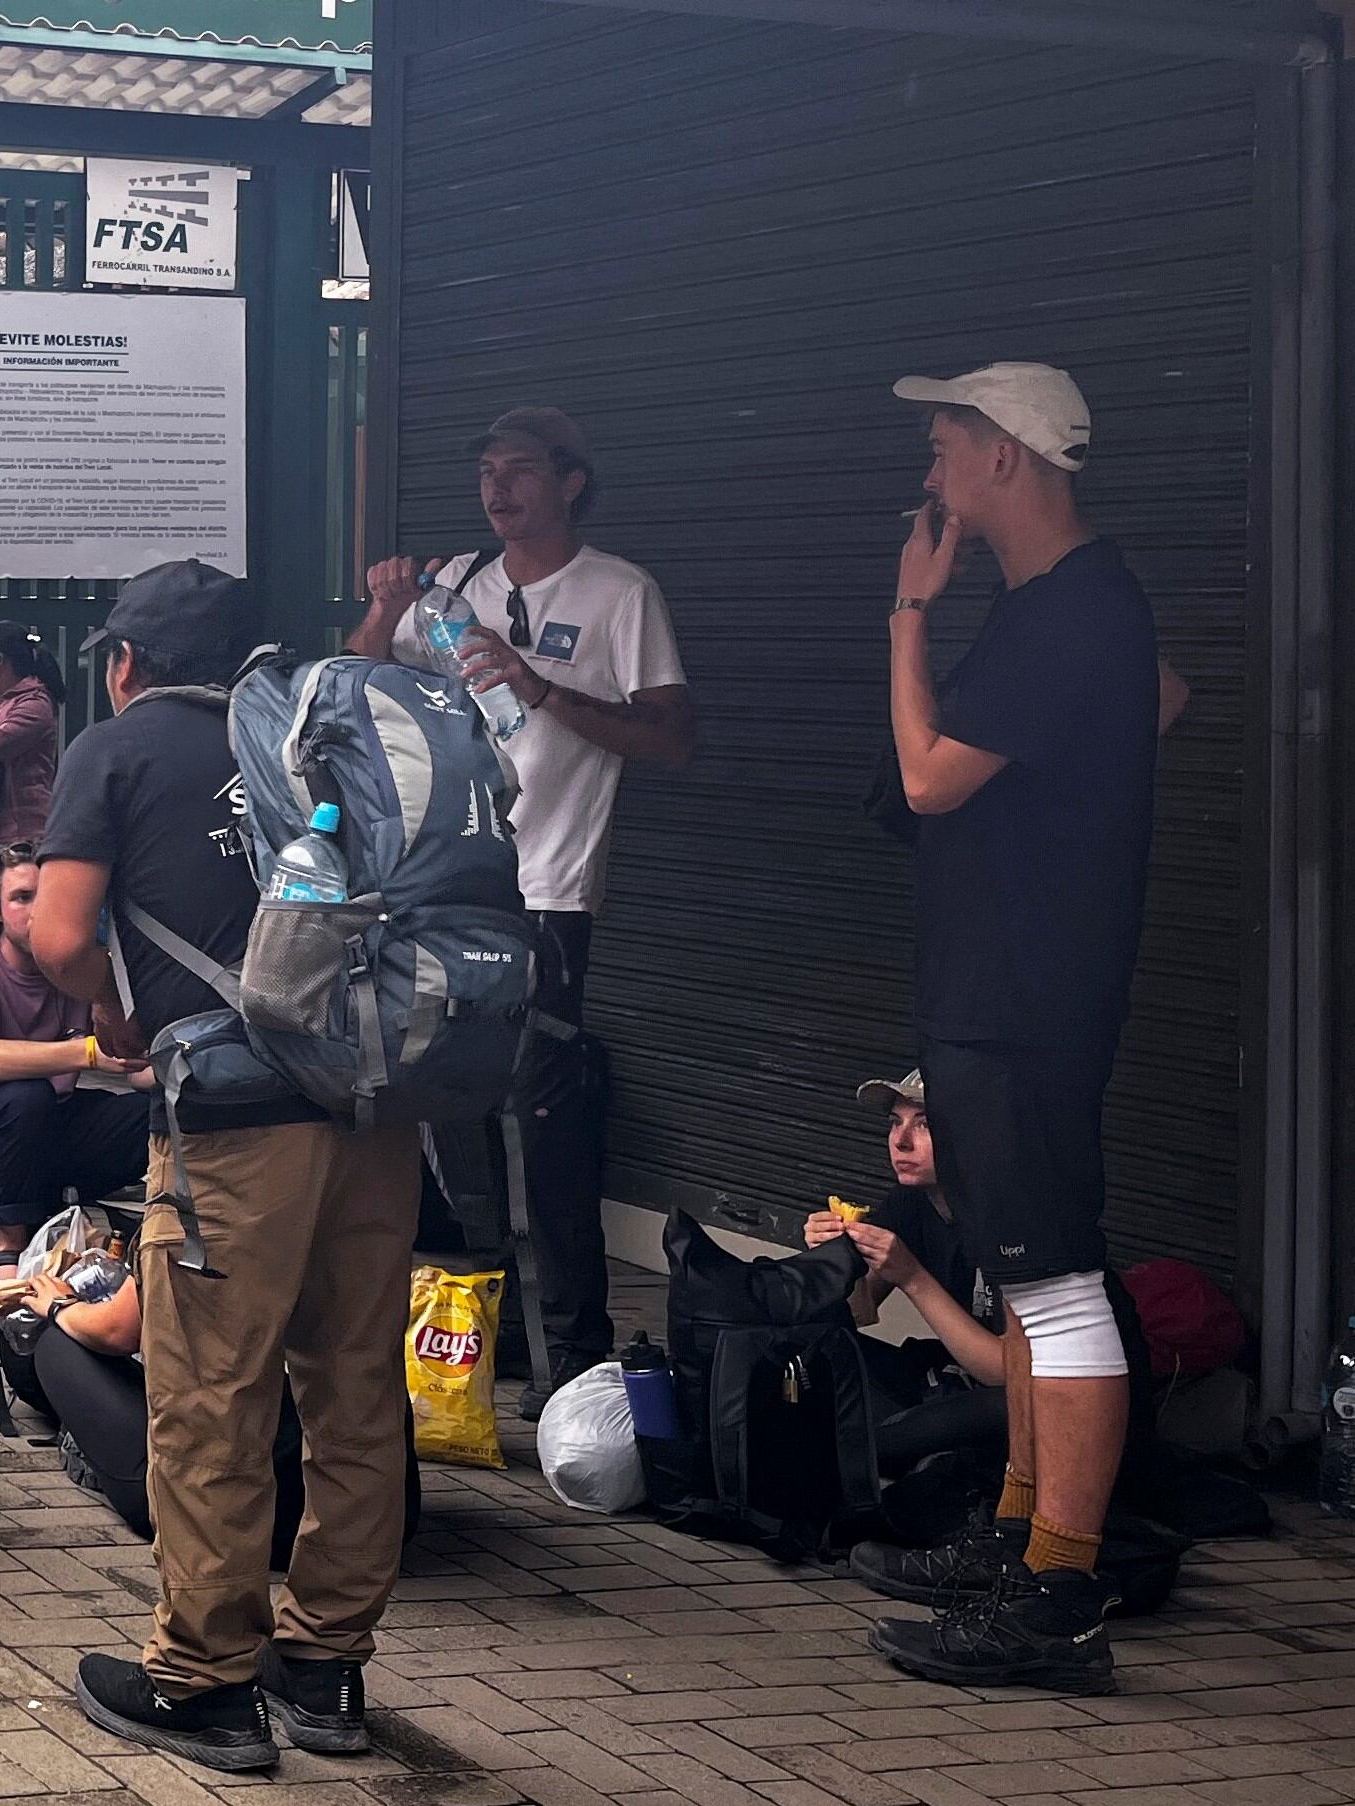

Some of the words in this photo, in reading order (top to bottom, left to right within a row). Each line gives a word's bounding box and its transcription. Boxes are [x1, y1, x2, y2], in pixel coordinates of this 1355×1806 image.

[93, 218, 189, 254] FTSA
[92, 260, 151, 272] FERROCARRIL
[153, 264, 215, 276] TRANSANDINO
[44, 334, 128, 348] MOLESTIAS!
[3, 356, 63, 366] INFORMACIÓN
[65, 358, 120, 367] IMPORTANTE
[418, 1326, 481, 1367] Lay's
